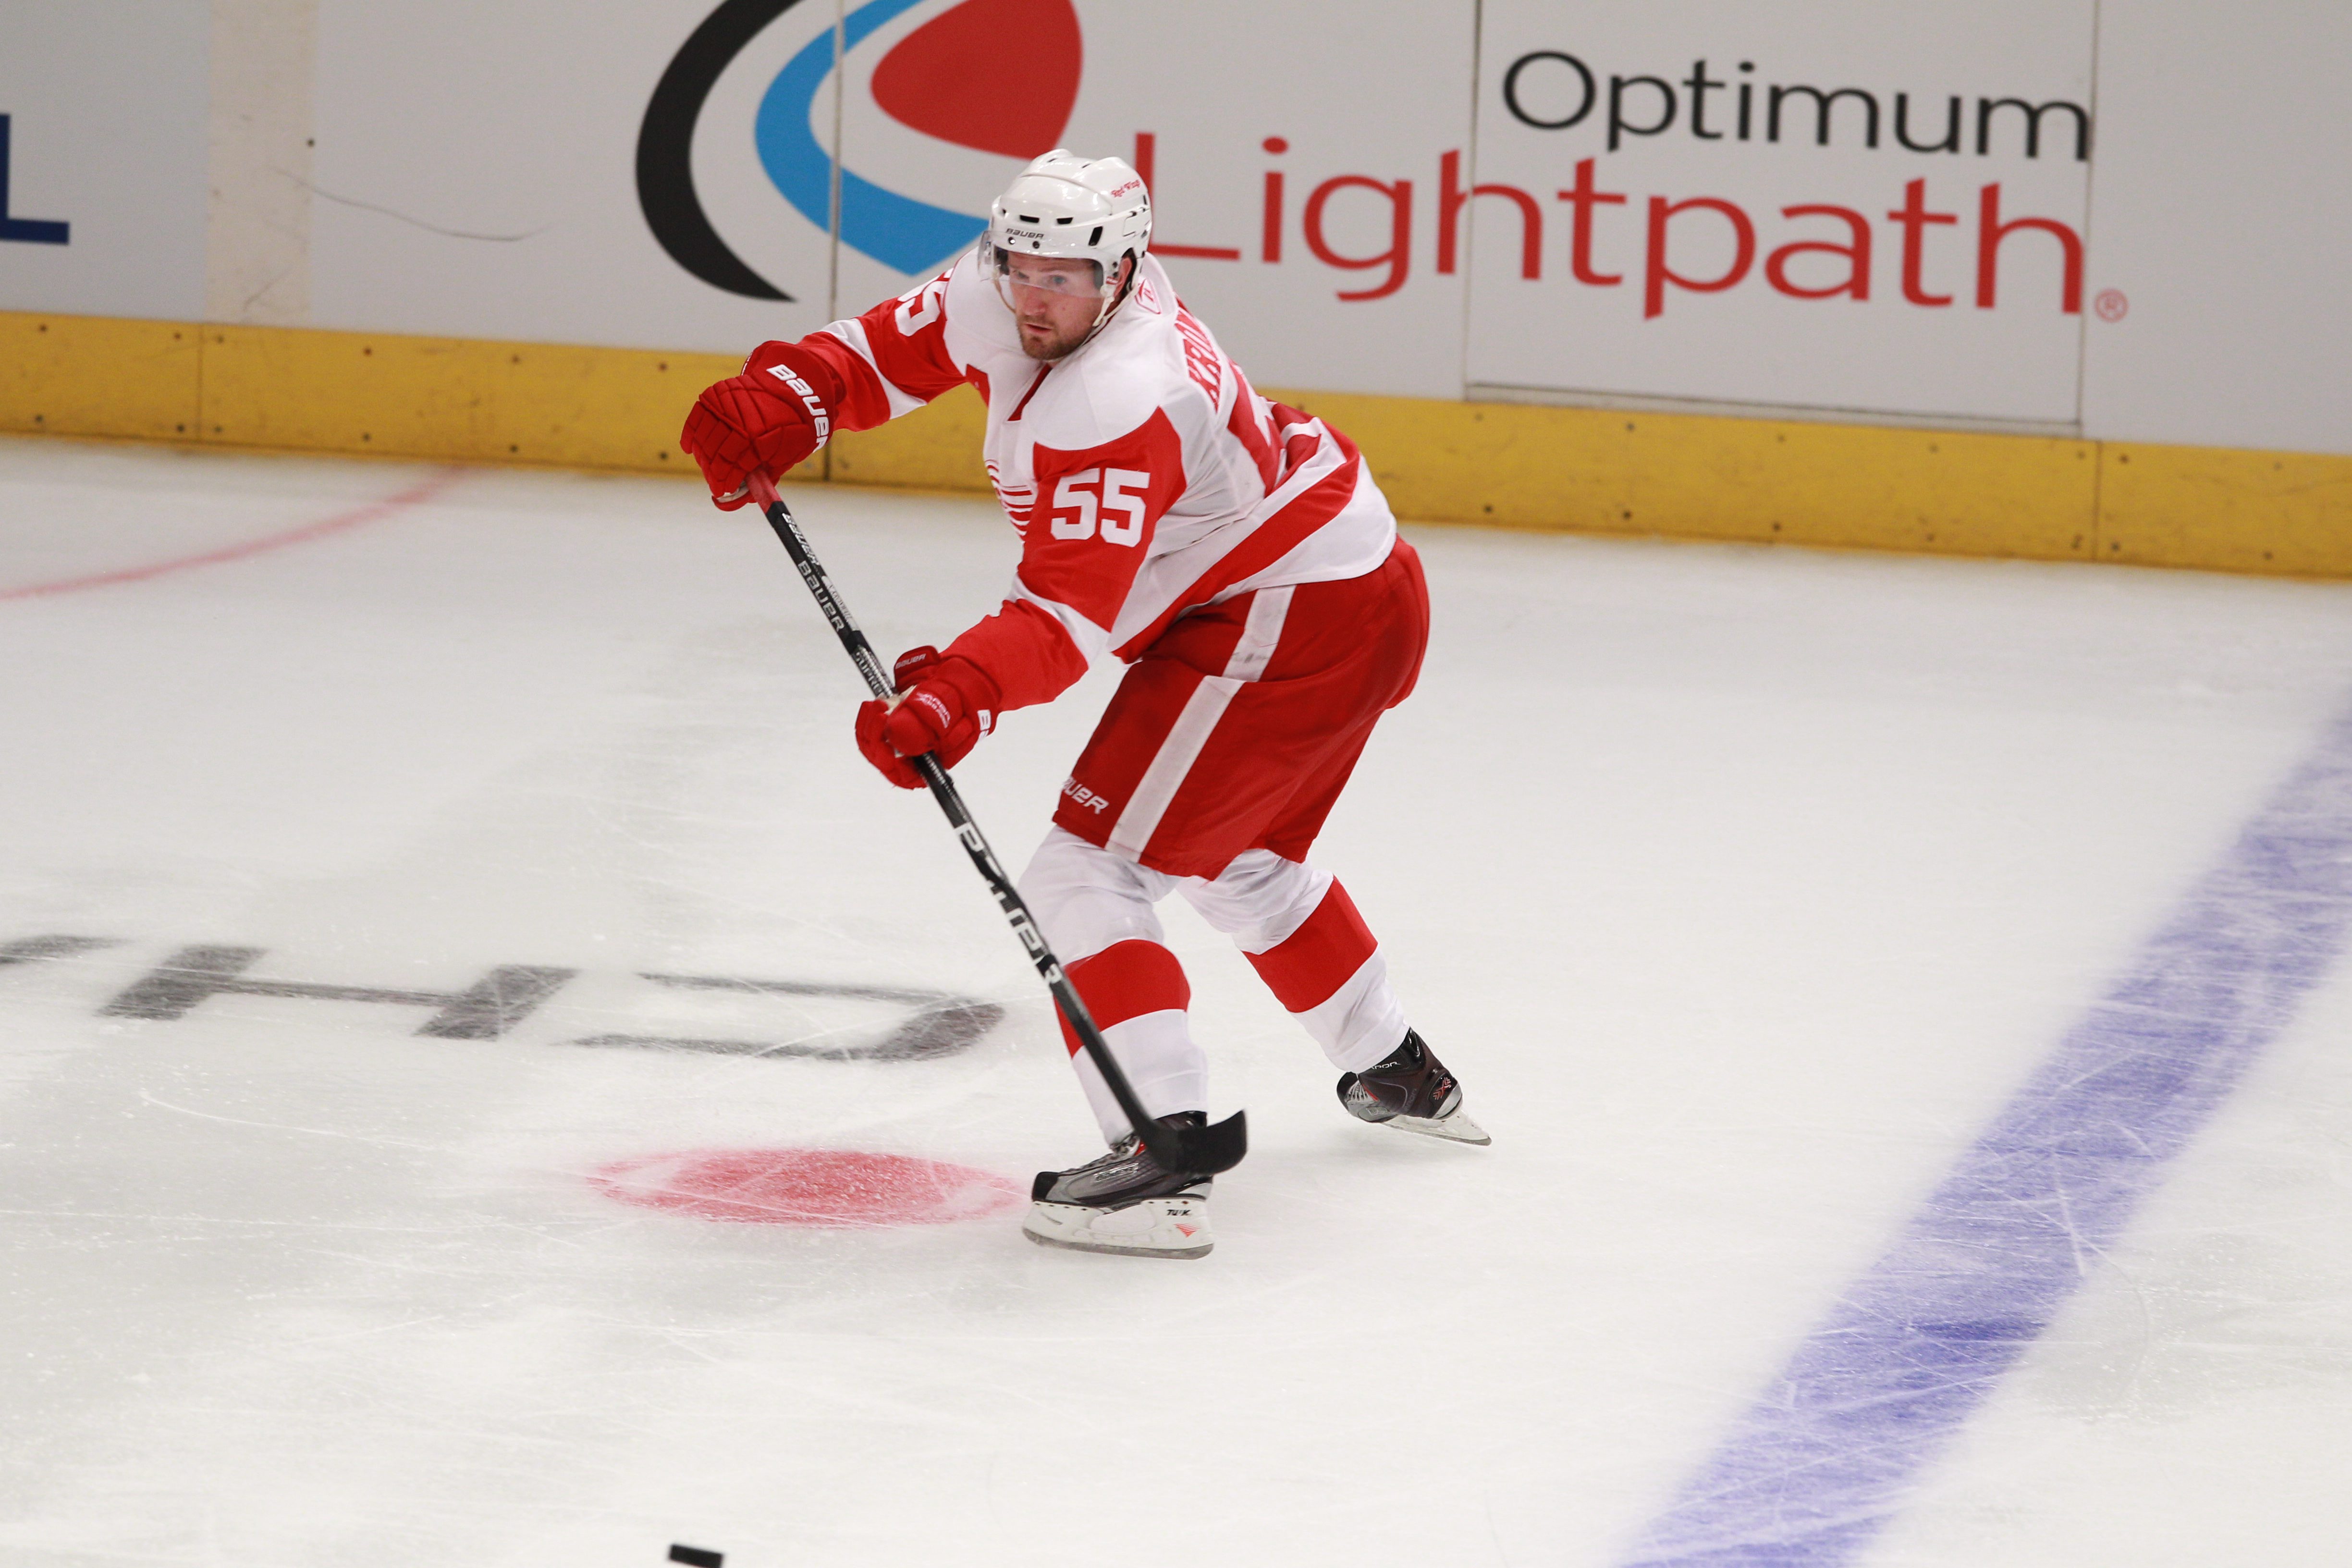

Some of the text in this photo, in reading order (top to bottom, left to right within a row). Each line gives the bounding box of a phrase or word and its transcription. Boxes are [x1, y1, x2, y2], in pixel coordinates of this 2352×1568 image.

[1503, 50, 2090, 160] Optimum
[1134, 132, 2083, 319] Lightpath
[1051, 467, 1151, 548] 55
[797, 560, 845, 632] BAUER
